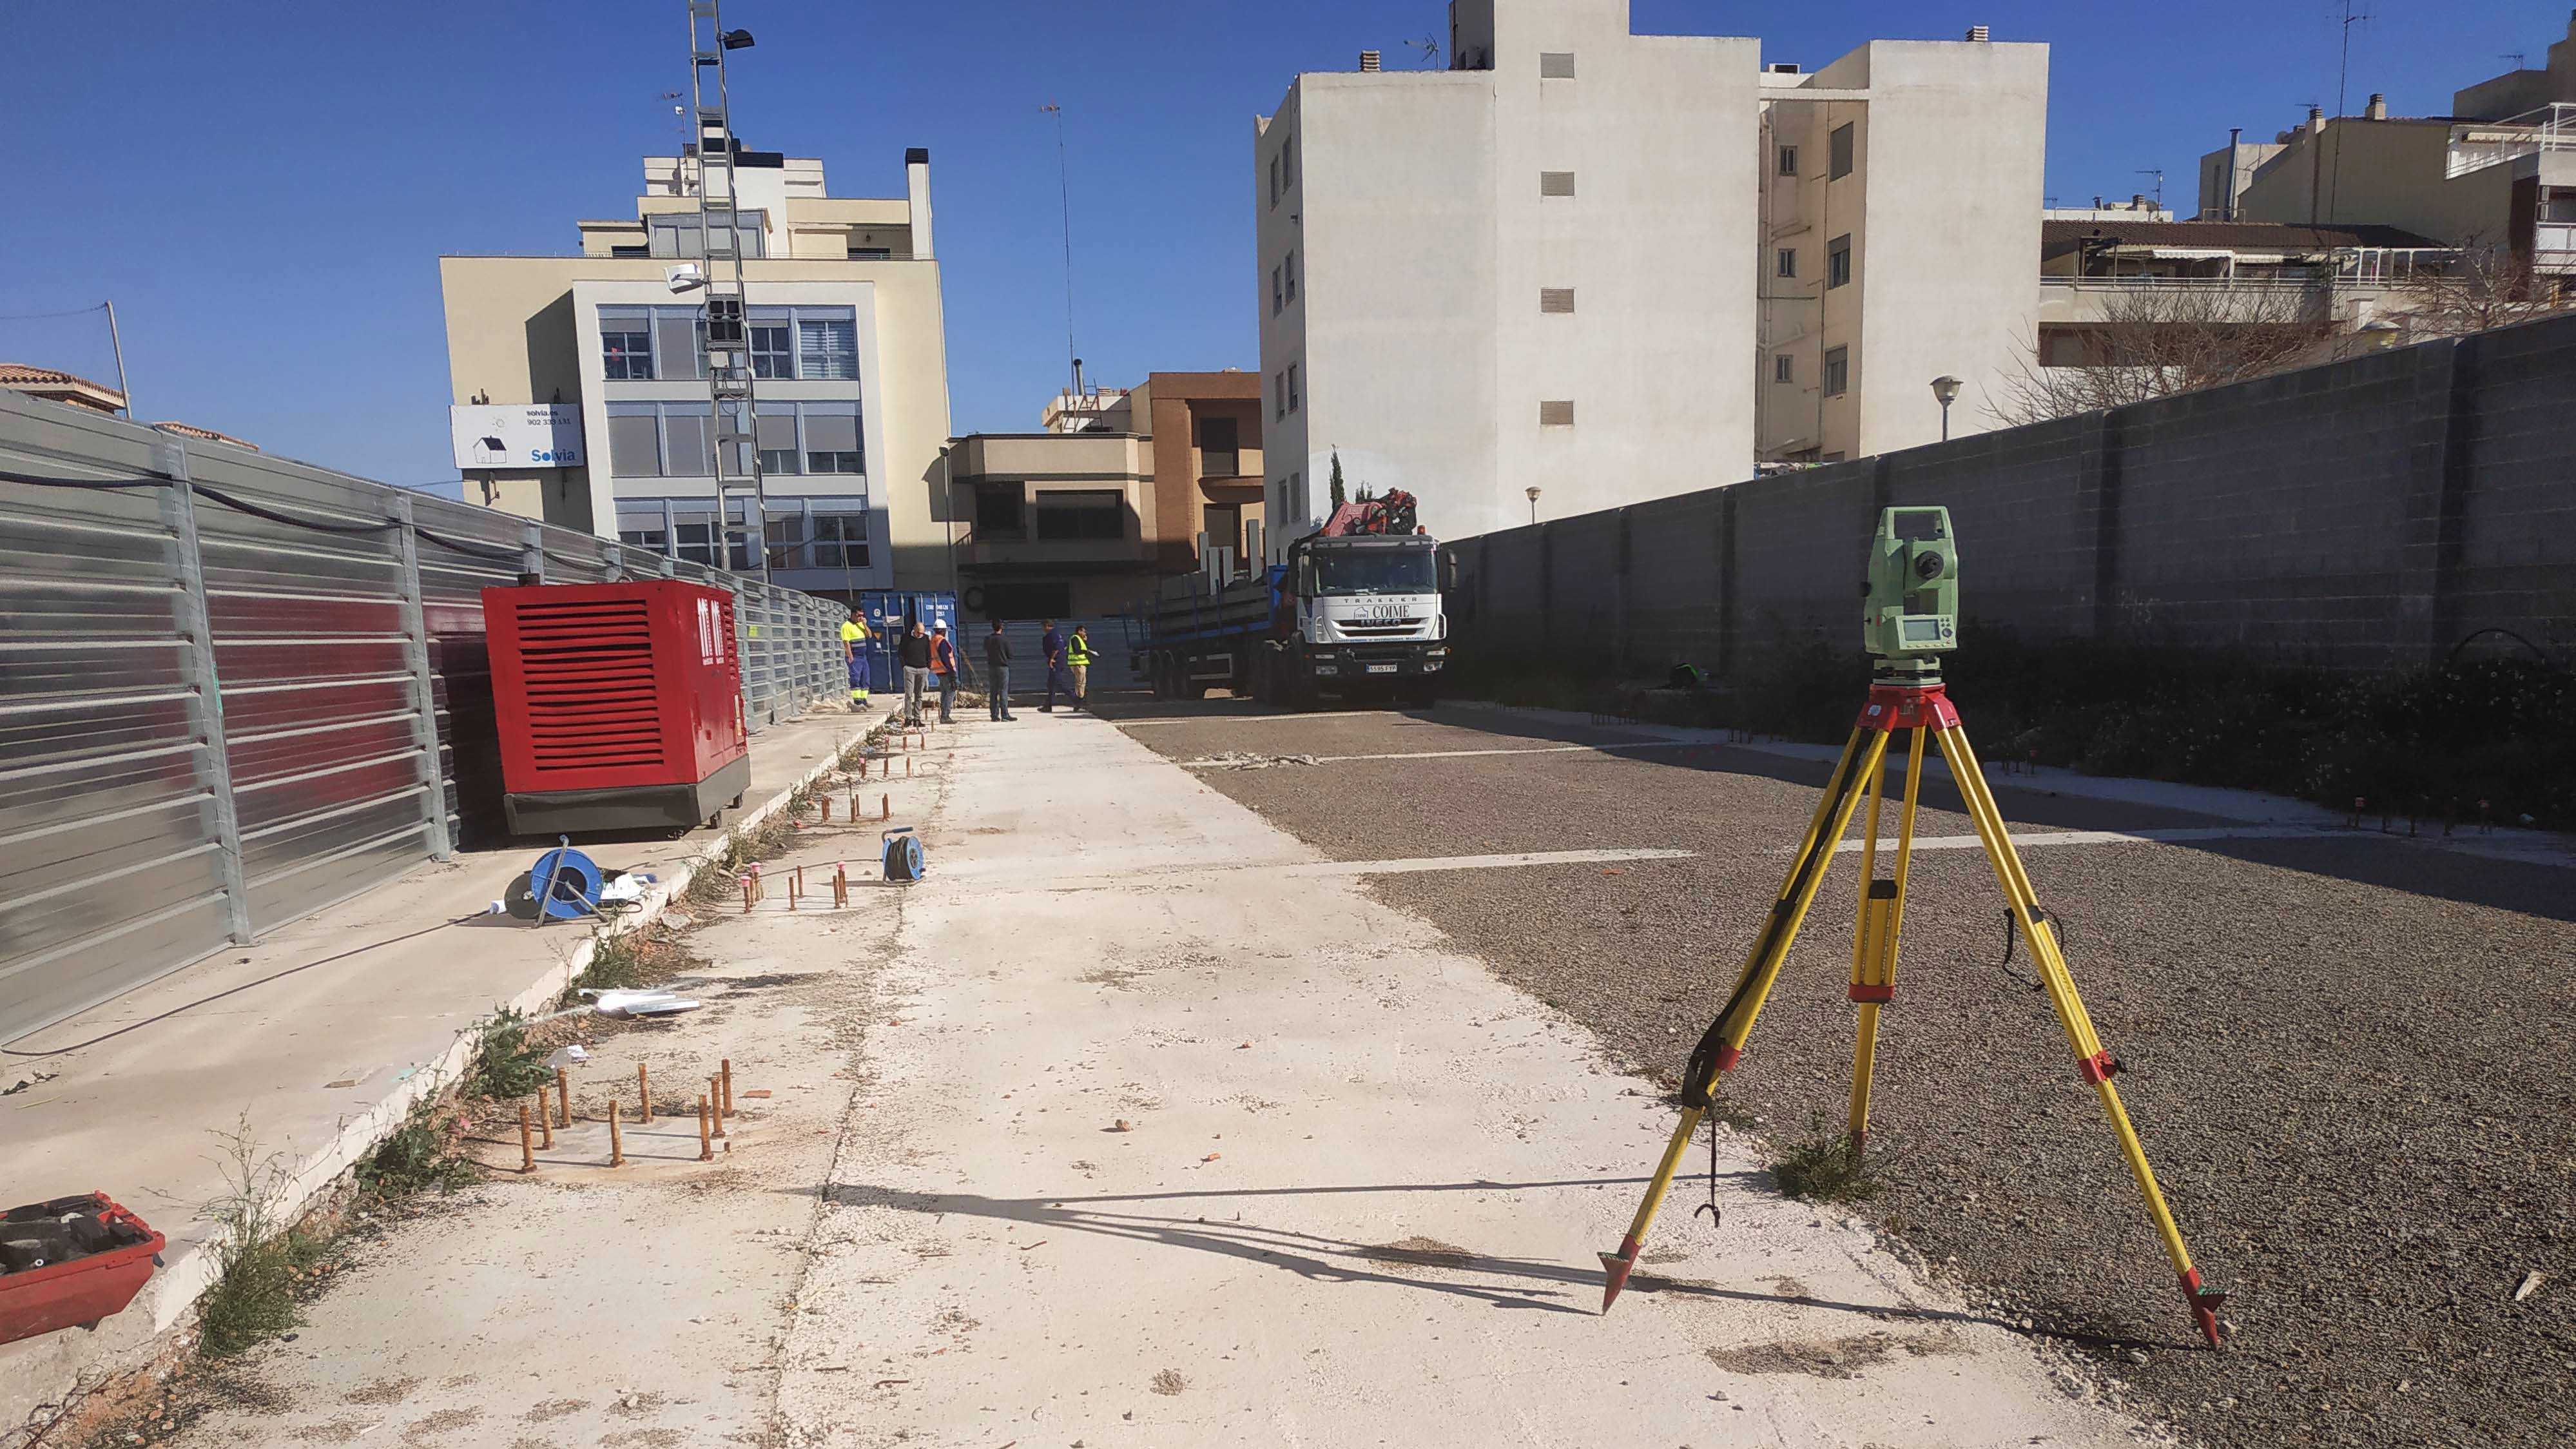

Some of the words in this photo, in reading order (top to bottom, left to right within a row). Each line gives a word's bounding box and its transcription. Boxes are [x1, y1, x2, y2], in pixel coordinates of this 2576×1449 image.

[532, 449, 575, 461] Solvia
[1373, 605, 1409, 619] COIME
[1361, 619, 1401, 627] IVECO
